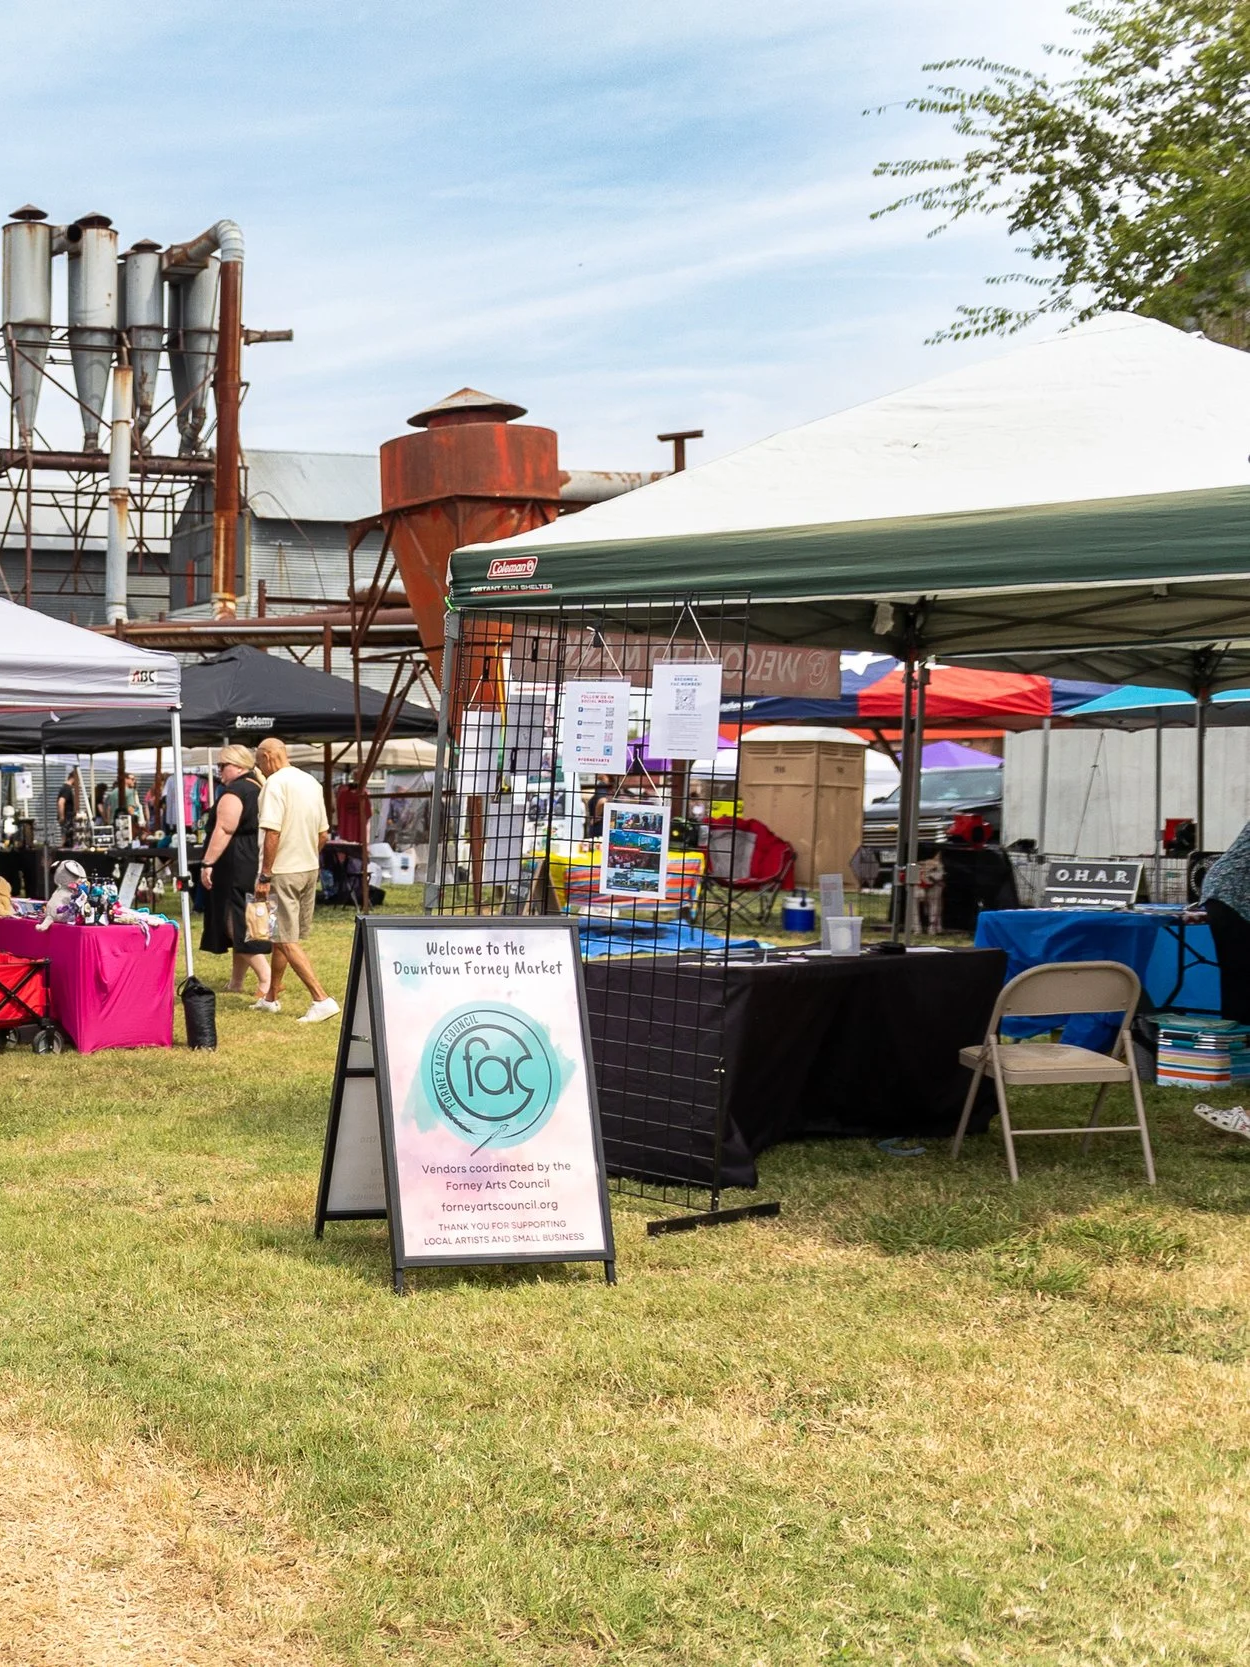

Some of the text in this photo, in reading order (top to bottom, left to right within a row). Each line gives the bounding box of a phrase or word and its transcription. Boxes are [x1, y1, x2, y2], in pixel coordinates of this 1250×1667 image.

[492, 561, 526, 574] Coleman
[131, 670, 156, 683] ABC
[236, 715, 275, 728] Academy
[426, 941, 526, 955] Welcome to the
[393, 960, 563, 978] Downtown Forney Market
[434, 1014, 479, 1110] FORNEY ARTS COUNCIL
[462, 1036, 535, 1097] fac
[422, 1161, 571, 1174] Vendors coordinated by the
[446, 1179, 550, 1192] Forney Arts Council
[441, 1200, 558, 1213] forneyartscouncil.org
[438, 1220, 567, 1231] THANK YOU FOR SUPPORTING
[424, 1233, 585, 1246] LOCAL ARTISTS AND SMALL BUSINESS
